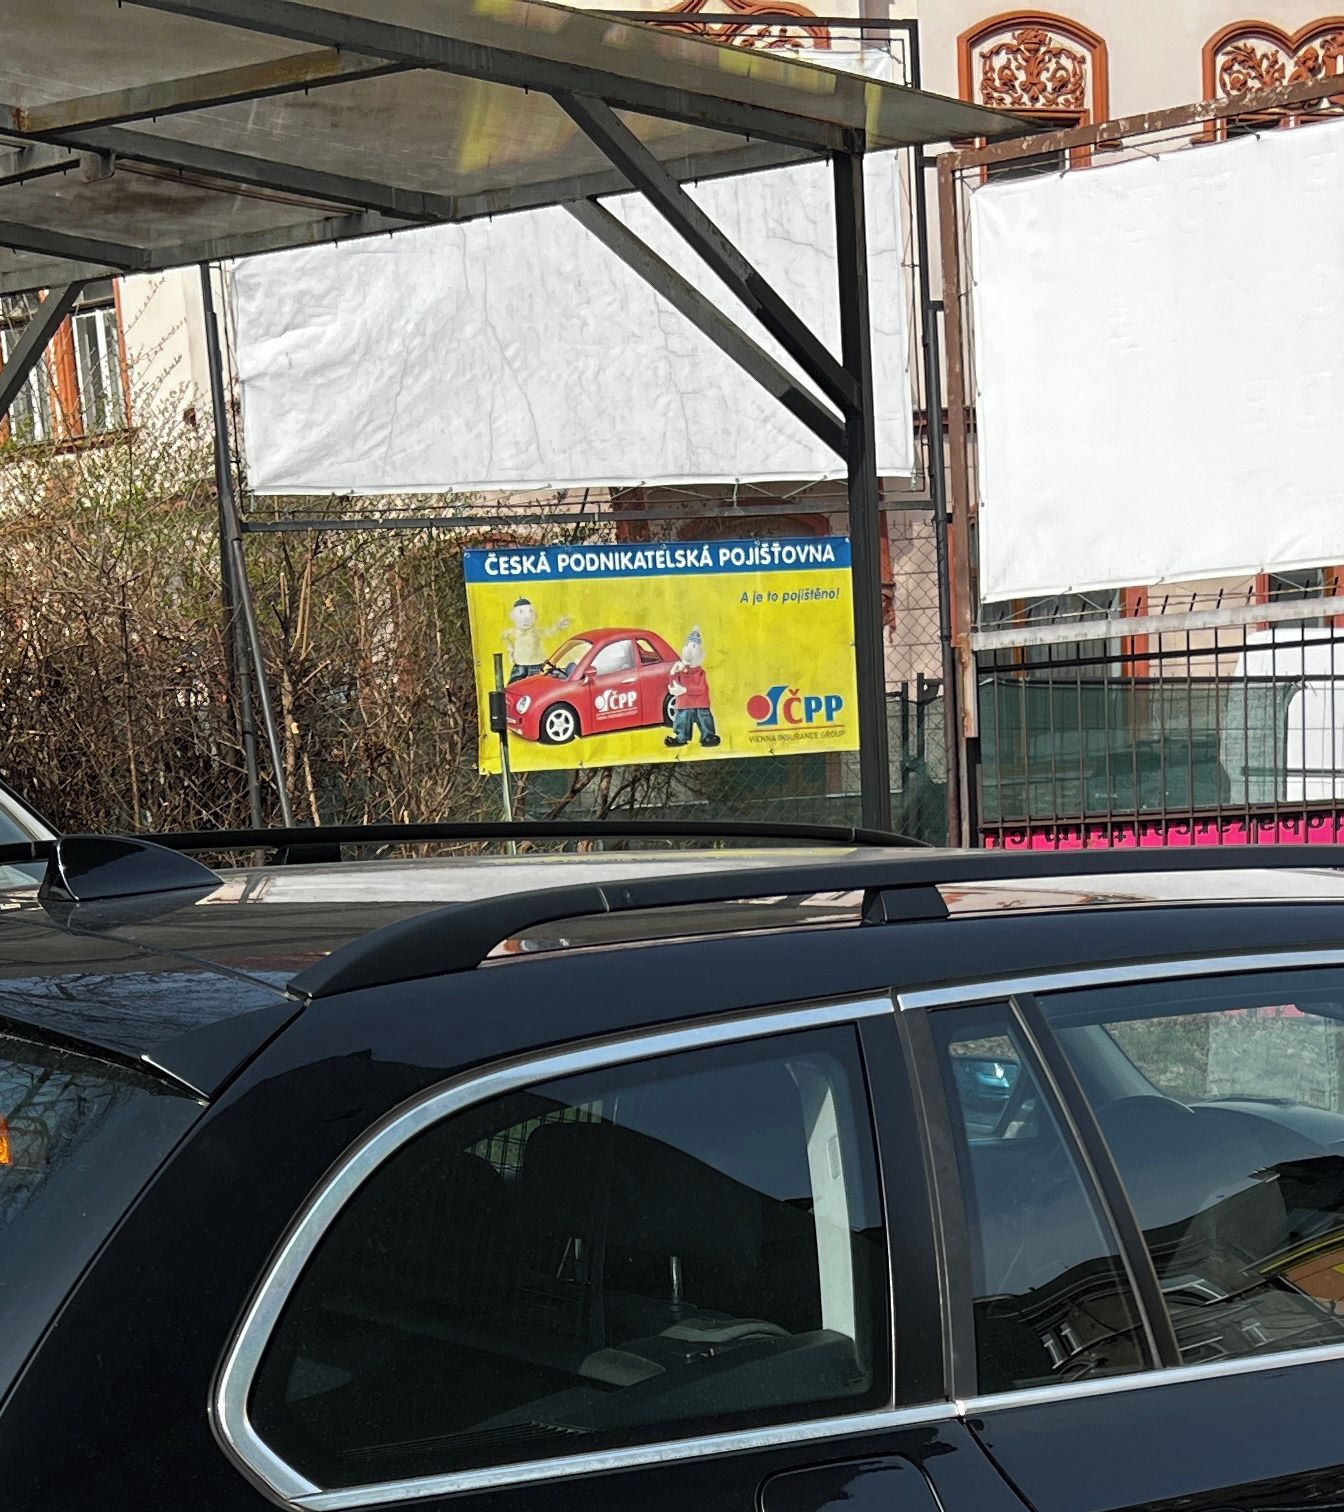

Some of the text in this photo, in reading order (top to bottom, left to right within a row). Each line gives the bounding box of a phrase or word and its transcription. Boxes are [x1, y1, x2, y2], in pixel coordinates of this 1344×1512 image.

[484, 541, 836, 576] ČESKÁ PODNIKATELSKÁ POJIŠŤOVNA
[739, 587, 840, 606] A je to pojištěno!
[609, 690, 637, 709] ČPP
[782, 688, 844, 725] ČPP
